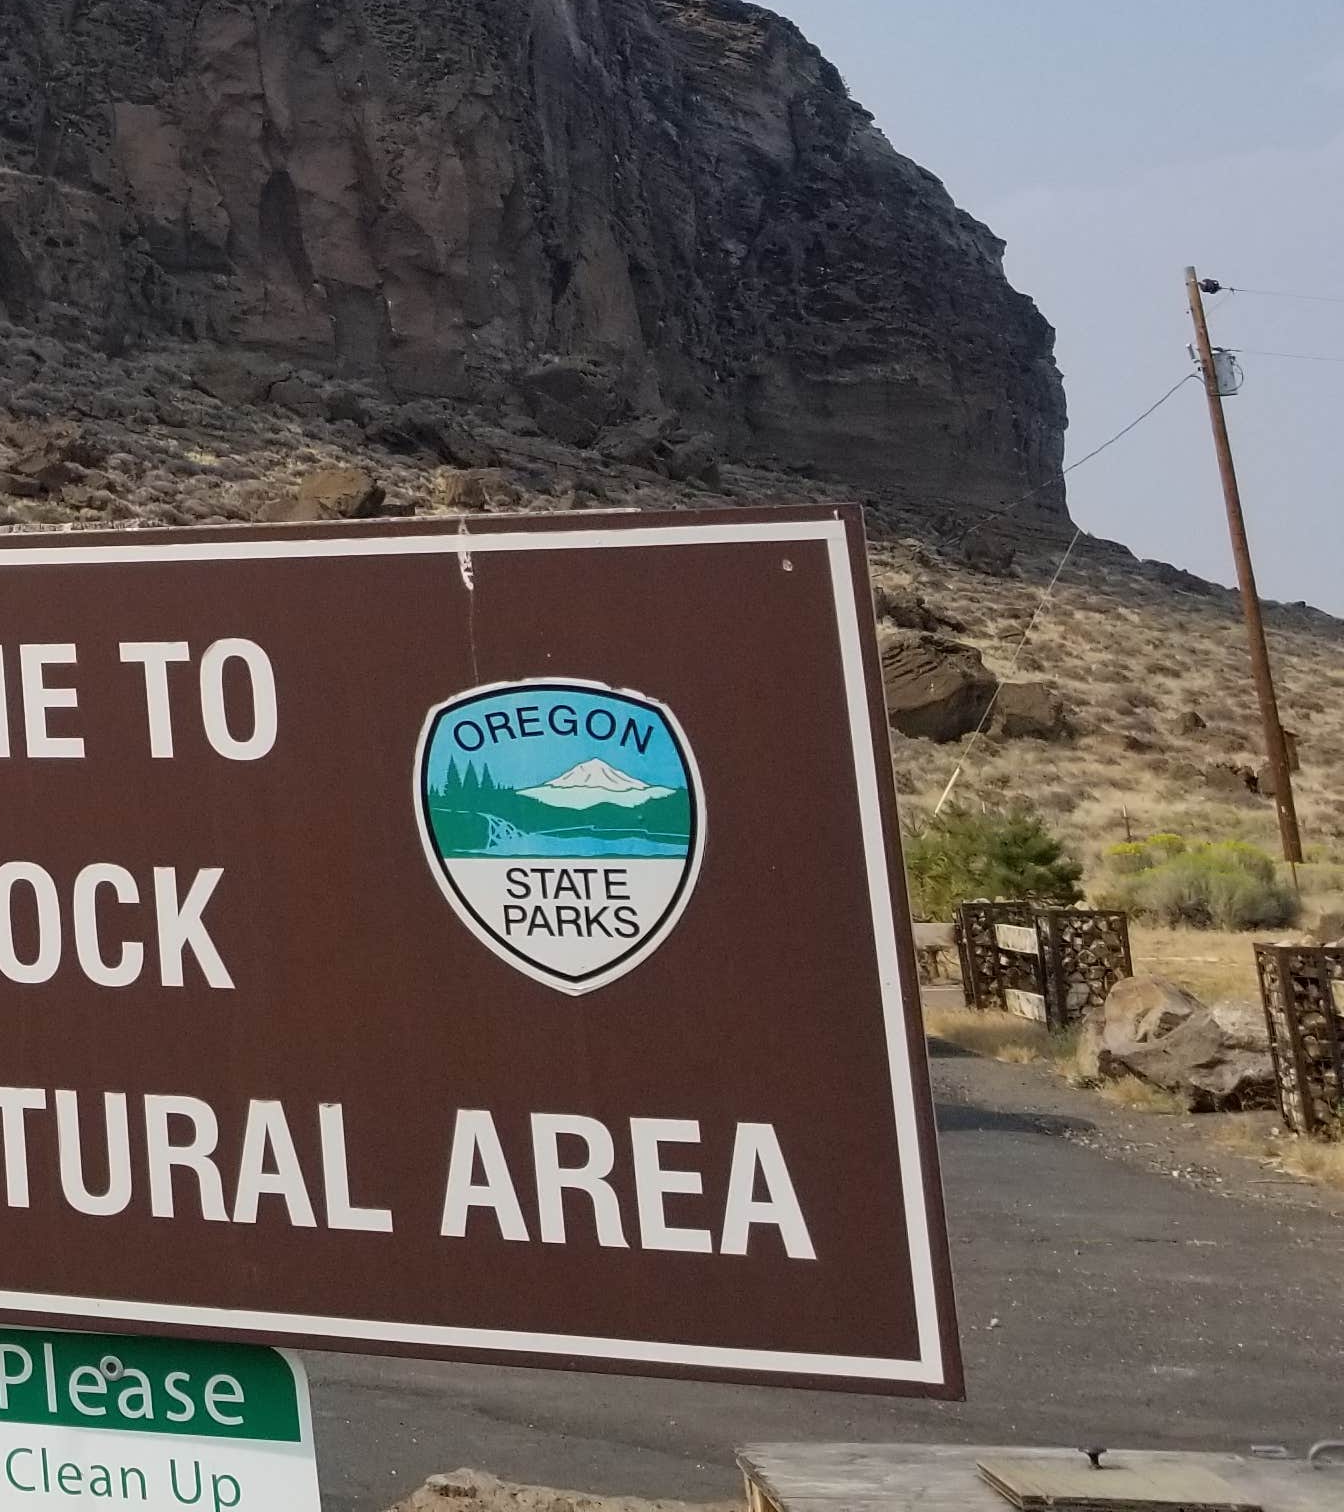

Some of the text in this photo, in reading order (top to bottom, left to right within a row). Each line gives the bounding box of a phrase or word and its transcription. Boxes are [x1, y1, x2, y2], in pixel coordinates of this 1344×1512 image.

[120, 637, 279, 762] TO
[453, 704, 654, 755] OREGON
[505, 867, 631, 901] STATE
[502, 904, 641, 939] PARKS
[439, 1107, 818, 1261] AREA
[4, 1447, 242, 1512] Clean Up
